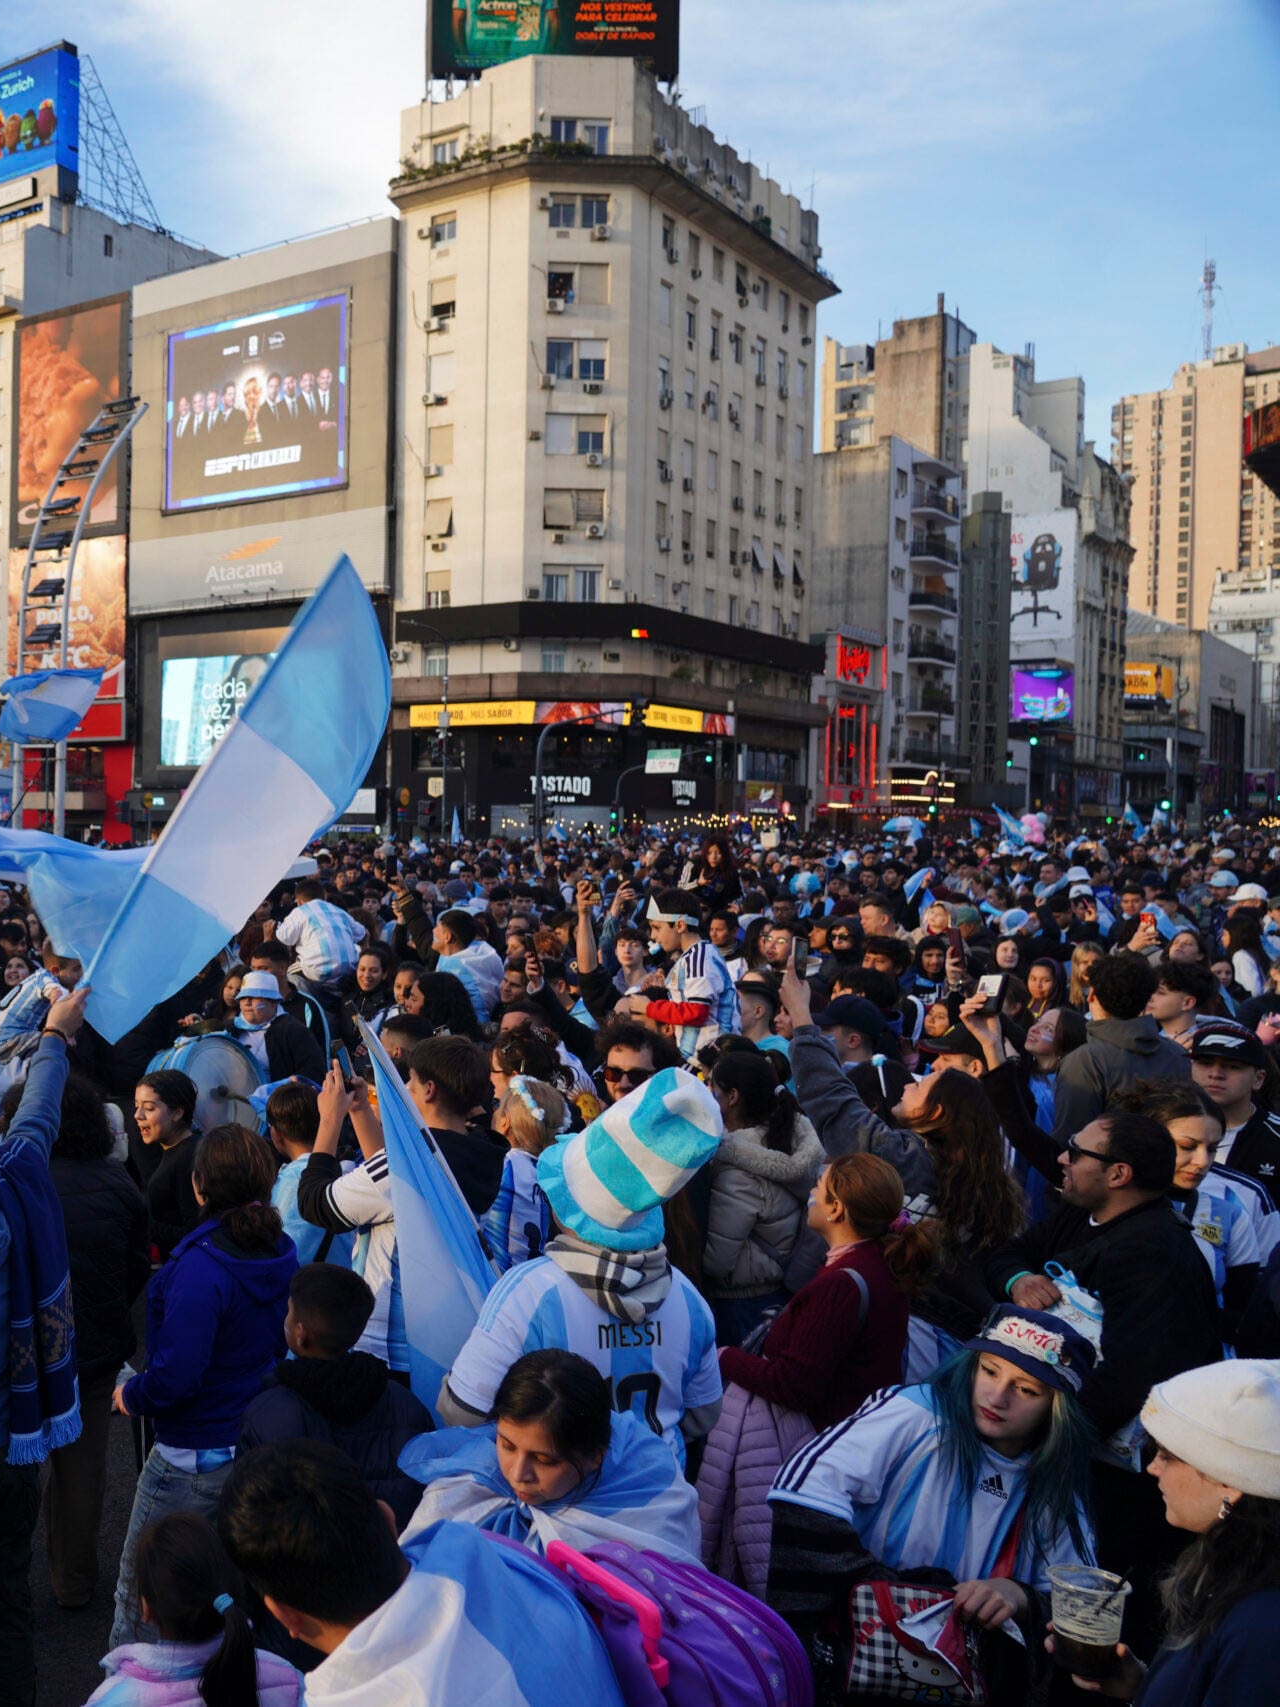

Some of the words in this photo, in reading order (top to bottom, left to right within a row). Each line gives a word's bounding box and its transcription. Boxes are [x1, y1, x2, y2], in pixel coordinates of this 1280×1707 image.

[580, 3, 601, 11] NOS
[575, 13, 602, 21] PARA
[605, 13, 657, 21] CELEBRAR
[607, 32, 618, 40] DE
[1, 75, 35, 100] Zurich
[204, 453, 252, 477] ESPN
[205, 560, 284, 583] Atacama
[201, 678, 247, 700] cada
[200, 702, 231, 720] vez
[487, 708, 512, 719] SABOR
[671, 779, 696, 799] TOSTADO
[598, 1320, 662, 1350] MESSI
[979, 1483, 1010, 1500] adidas
